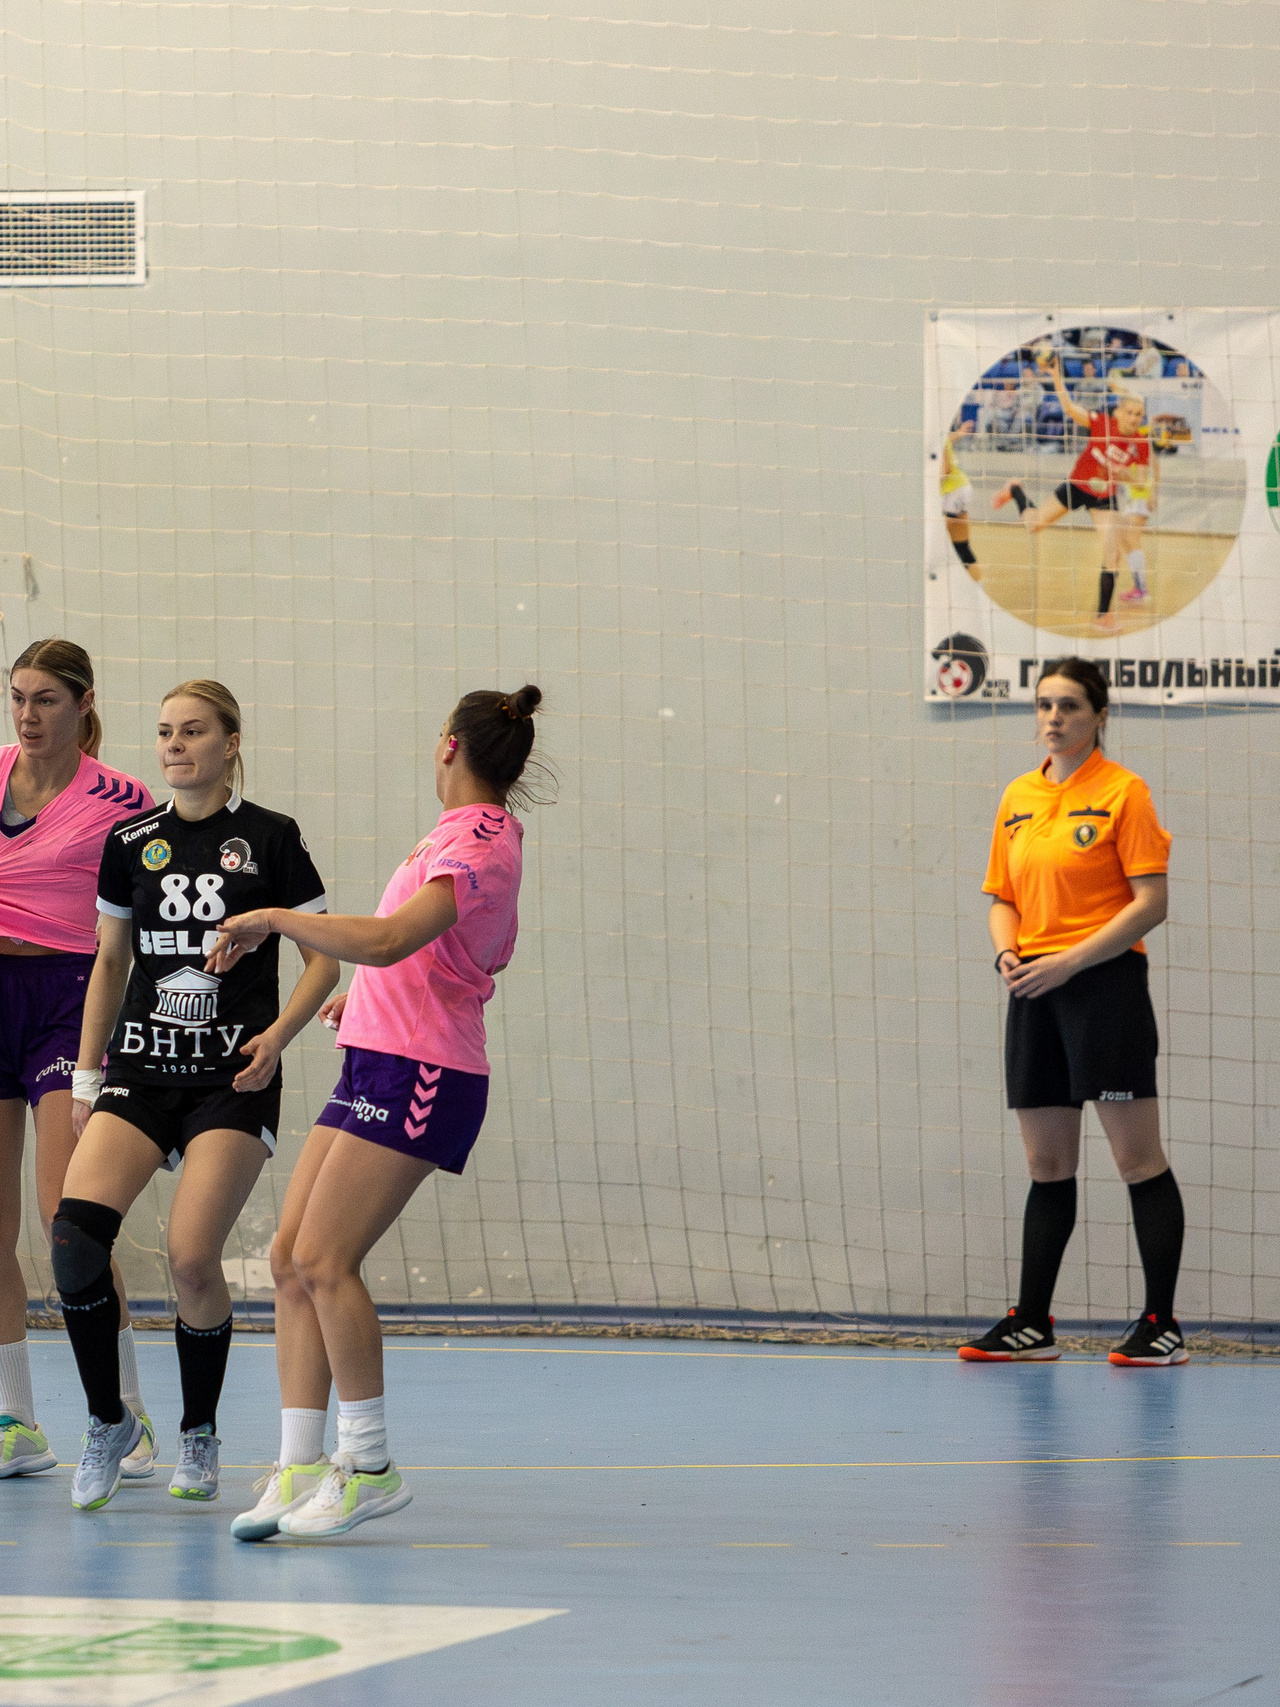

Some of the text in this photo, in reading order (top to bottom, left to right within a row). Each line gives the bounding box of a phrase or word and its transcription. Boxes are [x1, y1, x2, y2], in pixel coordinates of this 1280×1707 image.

[121, 821, 159, 844] Kempa
[159, 873, 225, 921] 88
[120, 1022, 244, 1058] БНТУ
[162, 1064, 198, 1074] 1920
